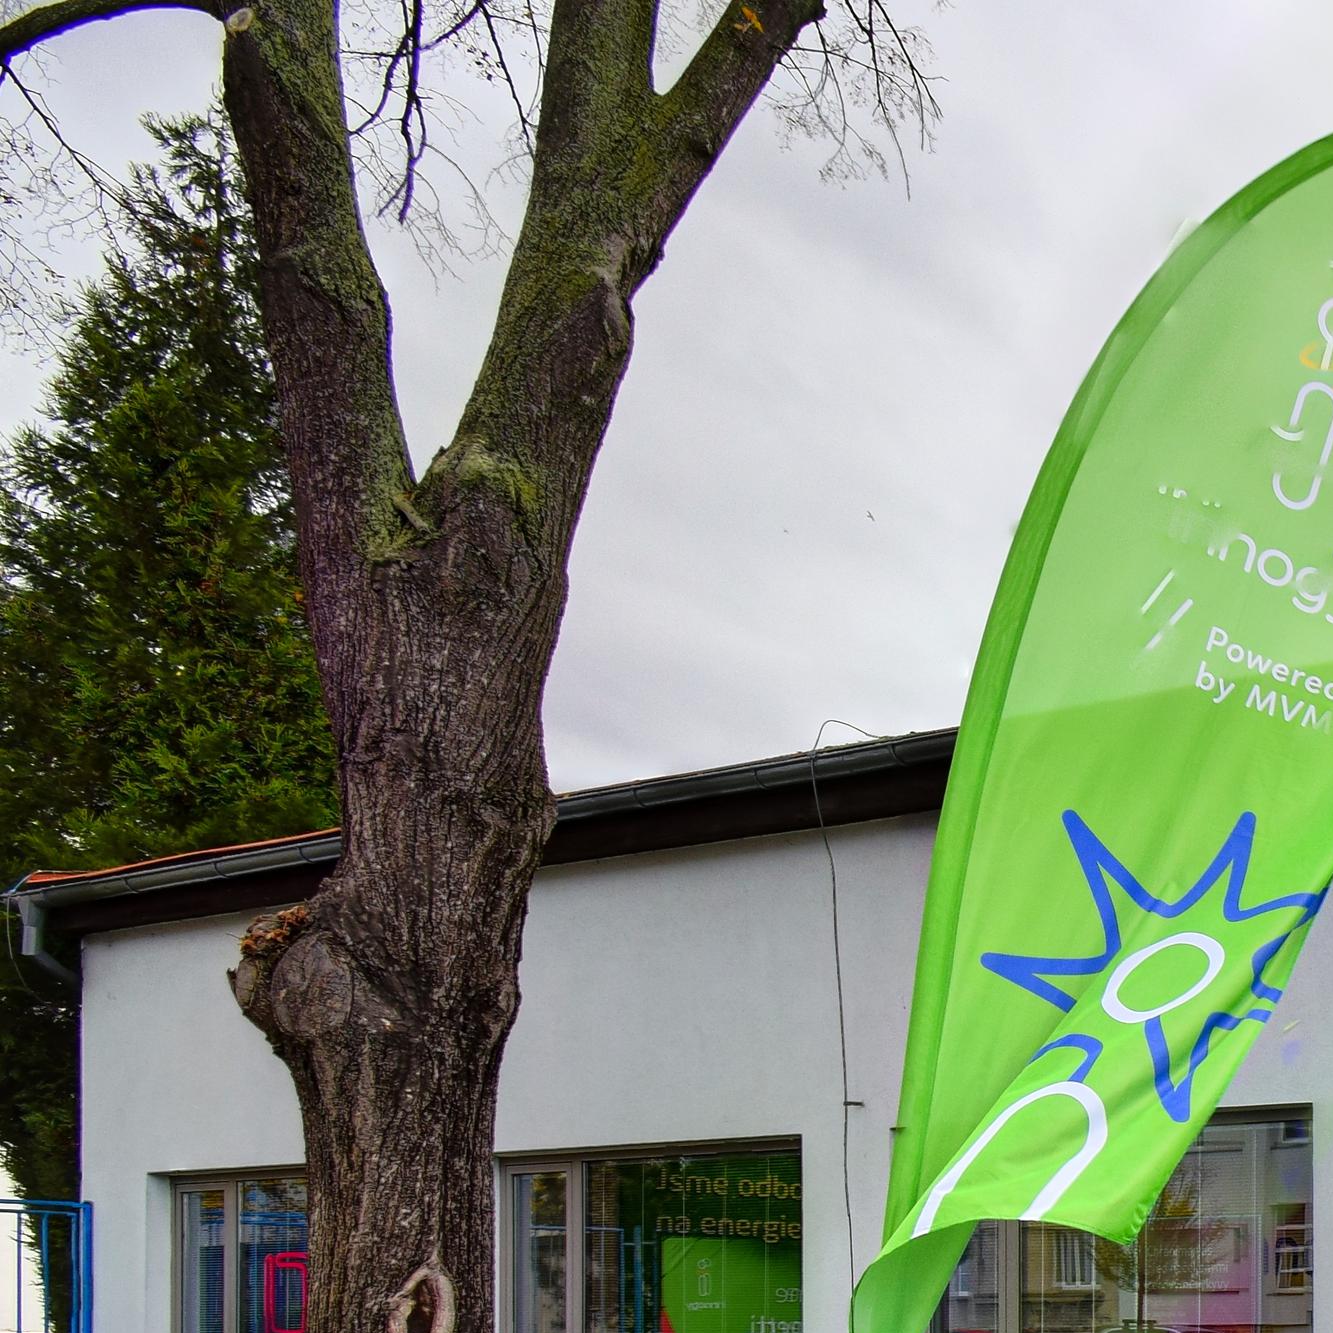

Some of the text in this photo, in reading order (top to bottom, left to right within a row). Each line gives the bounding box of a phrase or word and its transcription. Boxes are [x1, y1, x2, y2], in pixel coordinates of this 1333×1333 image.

[1194, 660, 1236, 704] by
[656, 1167, 729, 1195] Jsme
[656, 1215, 691, 1234] na
